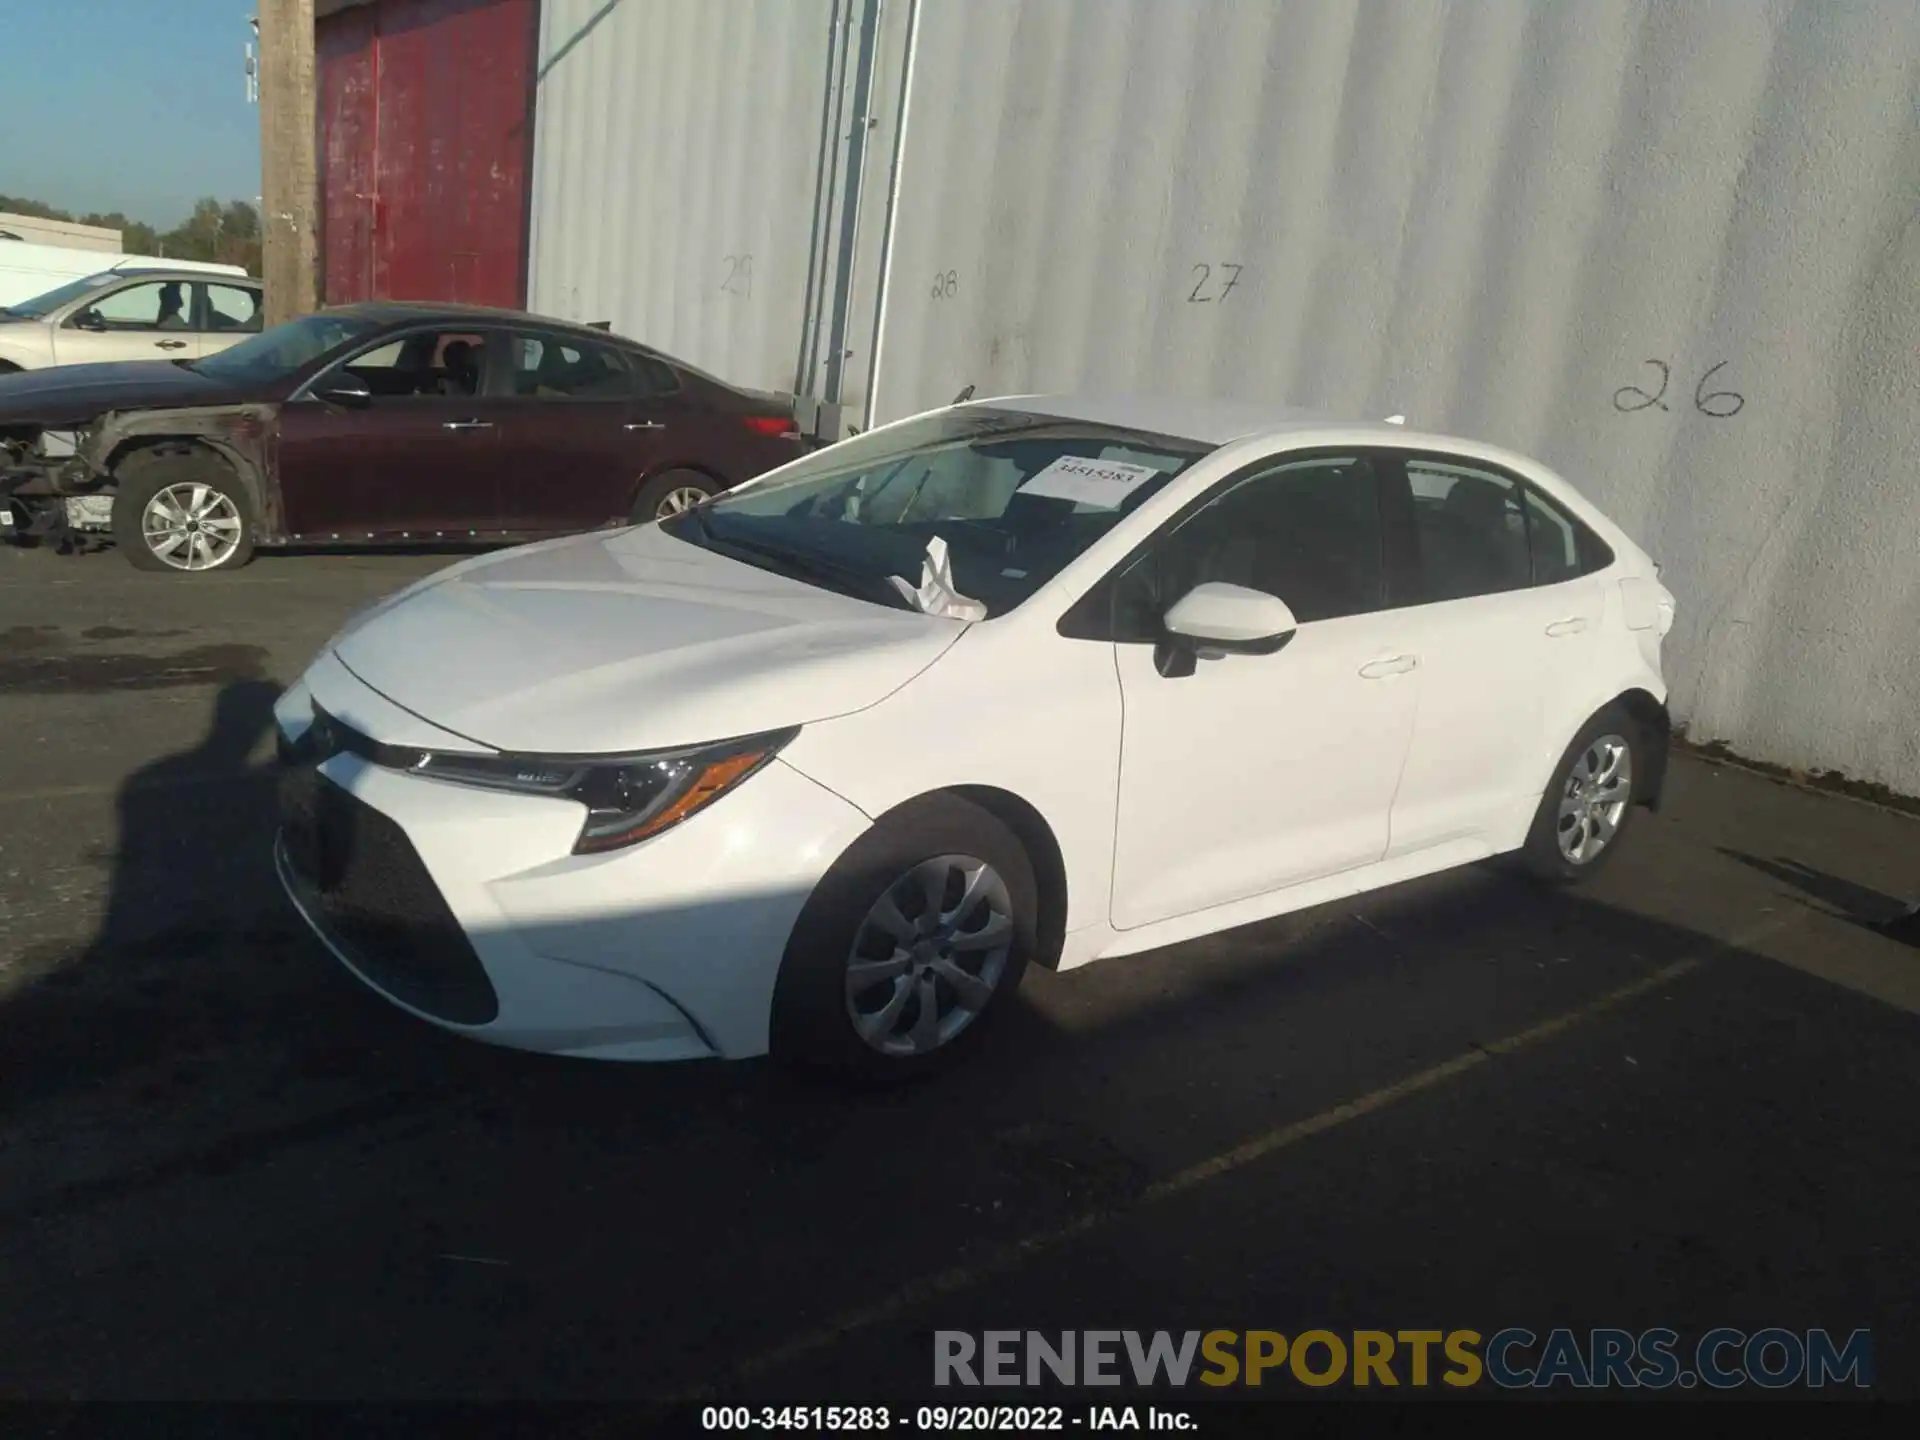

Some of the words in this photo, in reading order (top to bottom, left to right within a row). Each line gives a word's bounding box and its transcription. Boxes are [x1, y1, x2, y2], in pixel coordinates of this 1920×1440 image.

[931, 269, 960, 301] 28
[1187, 262, 1244, 304] 27
[1613, 359, 1744, 417] 26
[1055, 464, 1136, 483] 34515283
